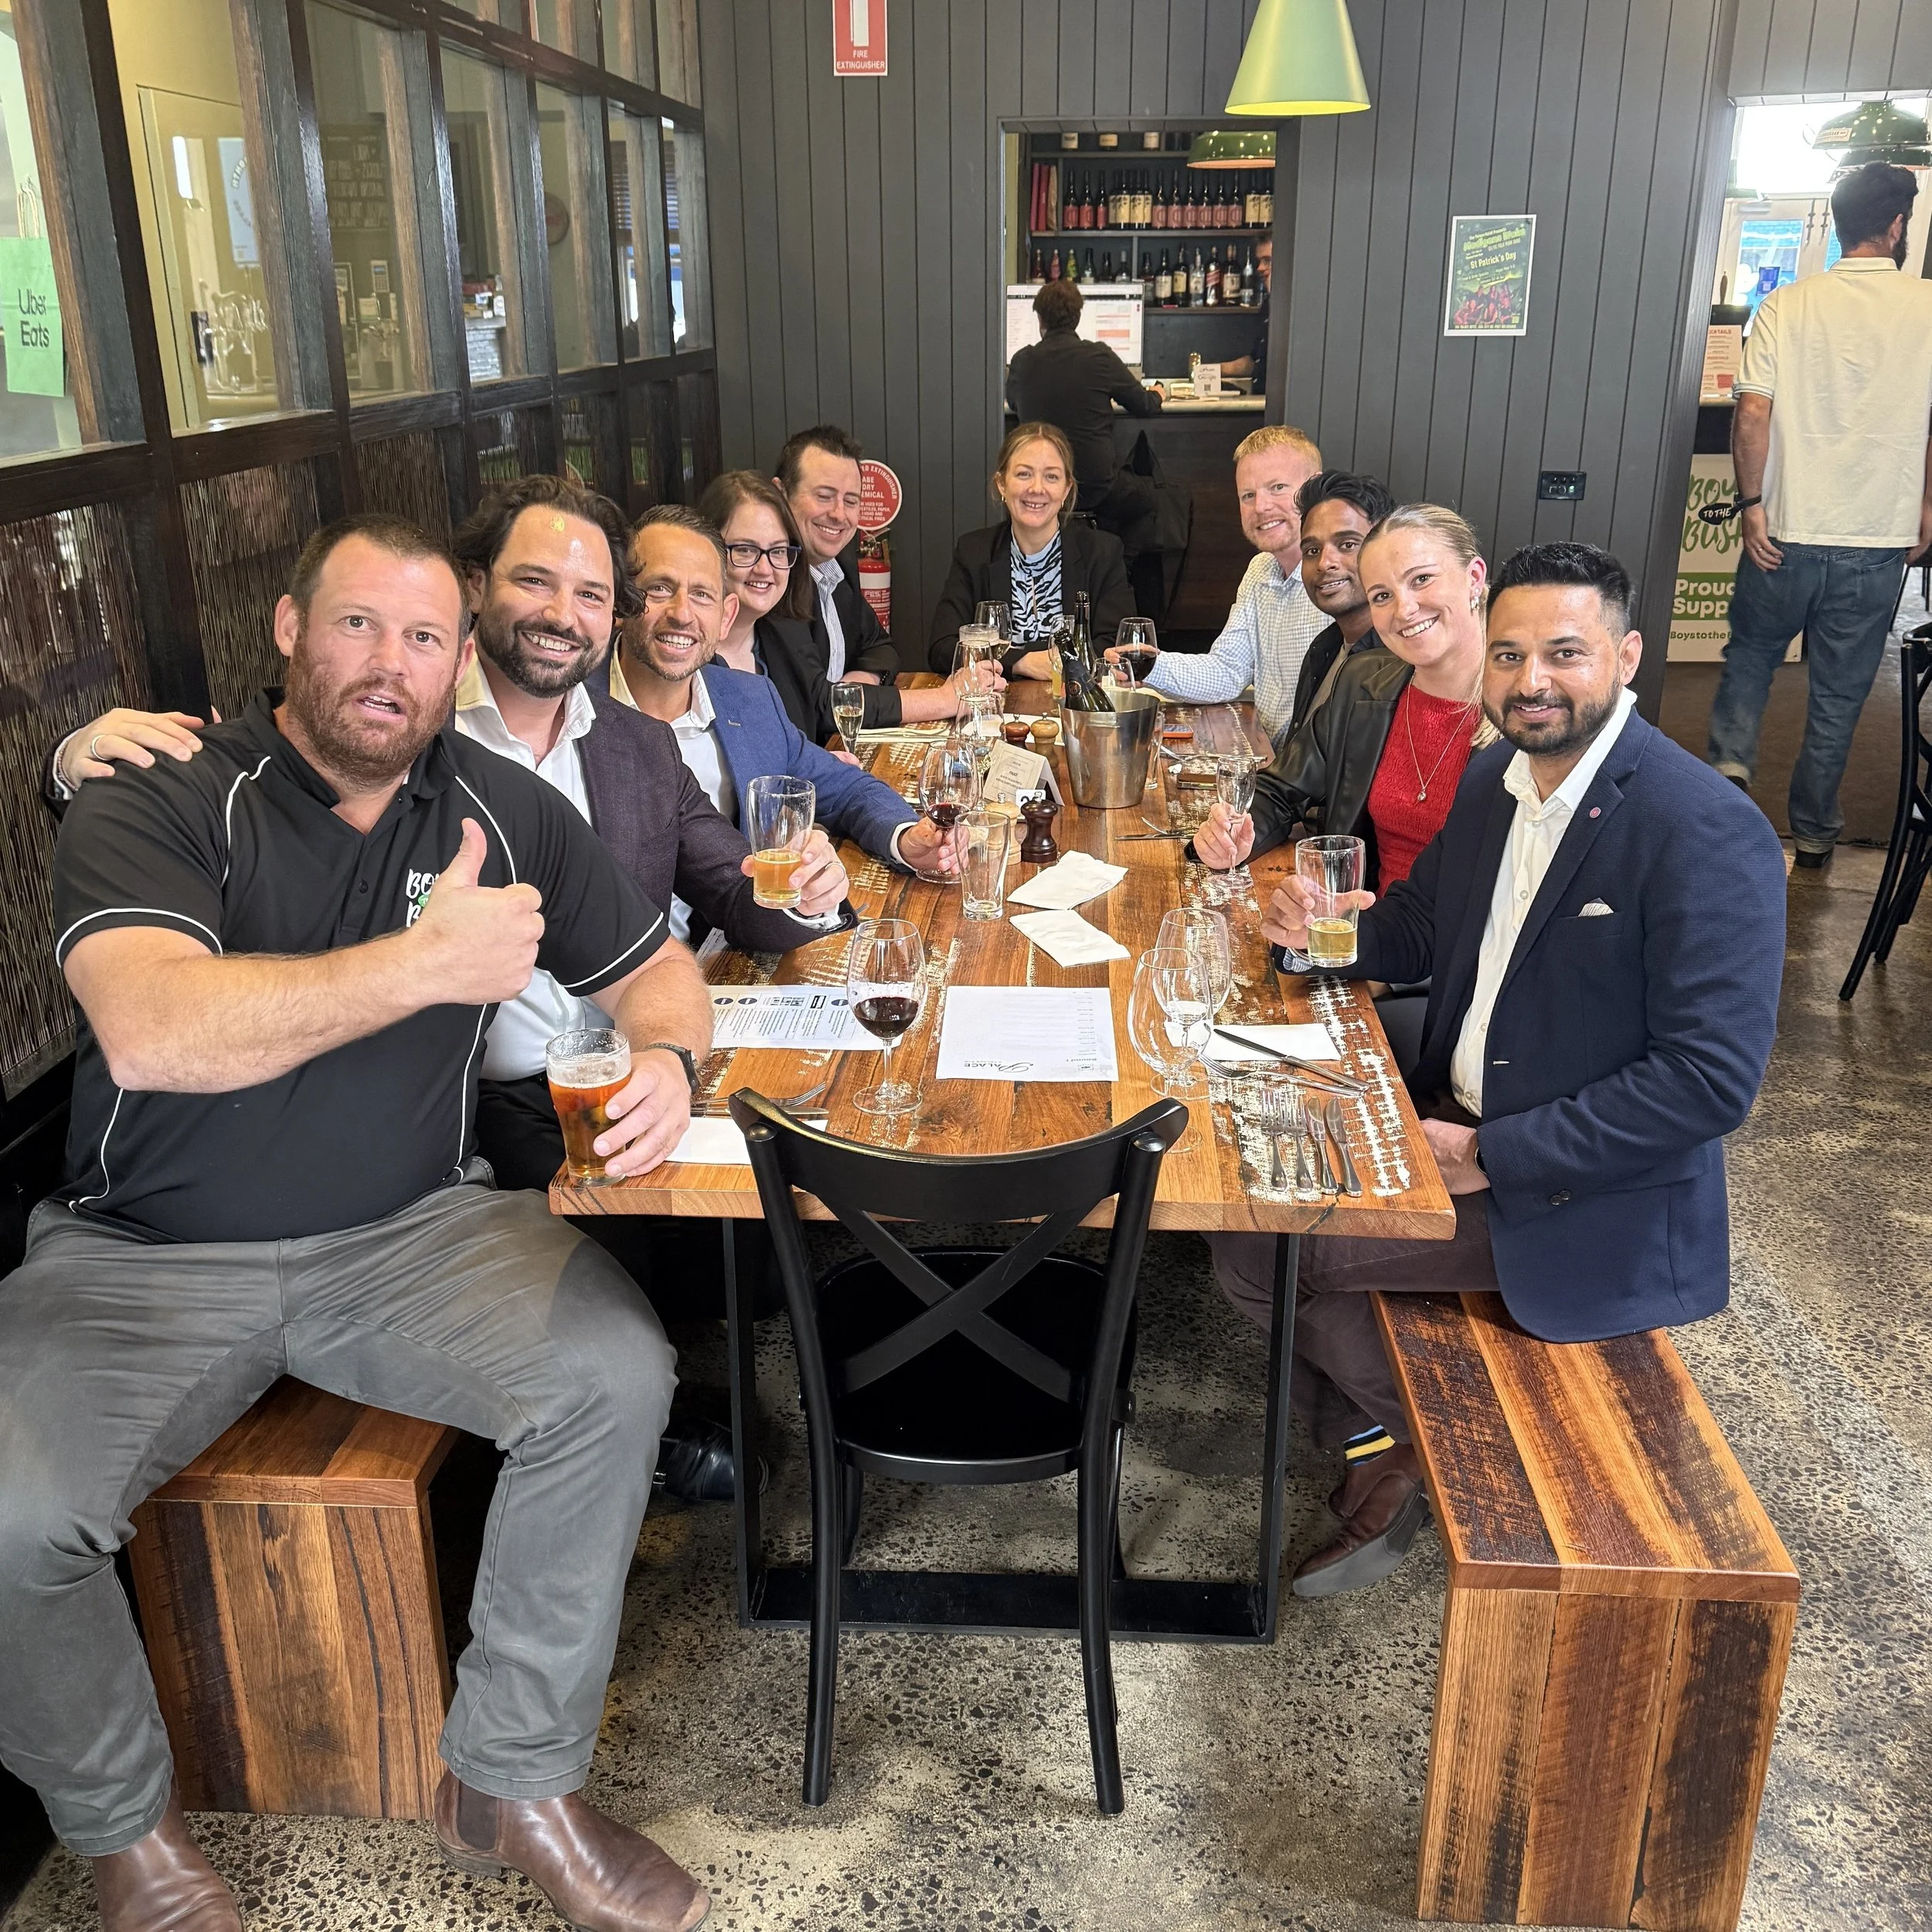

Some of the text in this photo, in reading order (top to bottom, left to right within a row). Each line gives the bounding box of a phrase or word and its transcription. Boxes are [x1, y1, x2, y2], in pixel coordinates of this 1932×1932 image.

[853, 49, 868, 58] FIRE
[837, 61, 885, 69] EXTINGUISHER
[1470, 260, 1478, 269] St
[1478, 254, 1504, 267] Patrick's
[1505, 252, 1516, 261] Day
[18, 287, 46, 315] Uber
[20, 320, 49, 348] Eats
[871, 465, 897, 499] EXTINGUISHER
[1714, 507, 1731, 518] THE
[1673, 597, 1729, 618] Supp
[406, 869, 439, 899] BO
